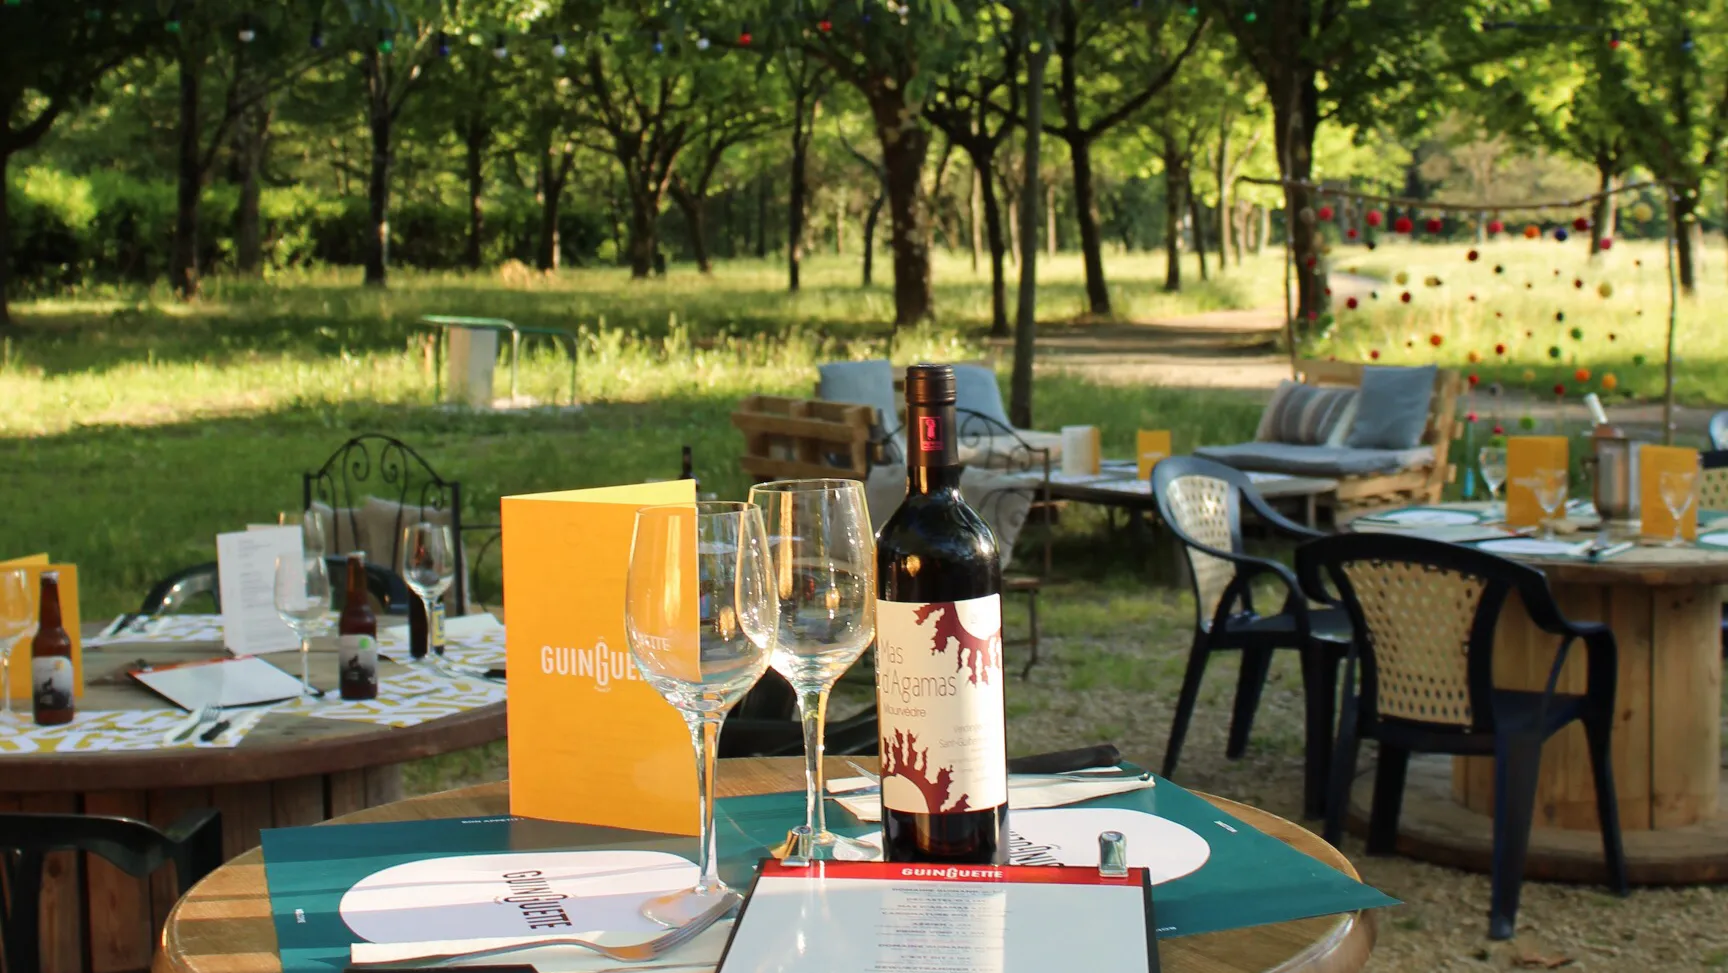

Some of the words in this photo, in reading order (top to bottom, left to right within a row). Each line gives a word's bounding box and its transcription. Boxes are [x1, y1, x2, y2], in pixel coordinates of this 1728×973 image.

[880, 640, 904, 664] Mas
[882, 668, 957, 704] d'Agamas
[901, 867, 1004, 879] GUINGUETTE
[502, 868, 572, 929] GUINGUETTE
